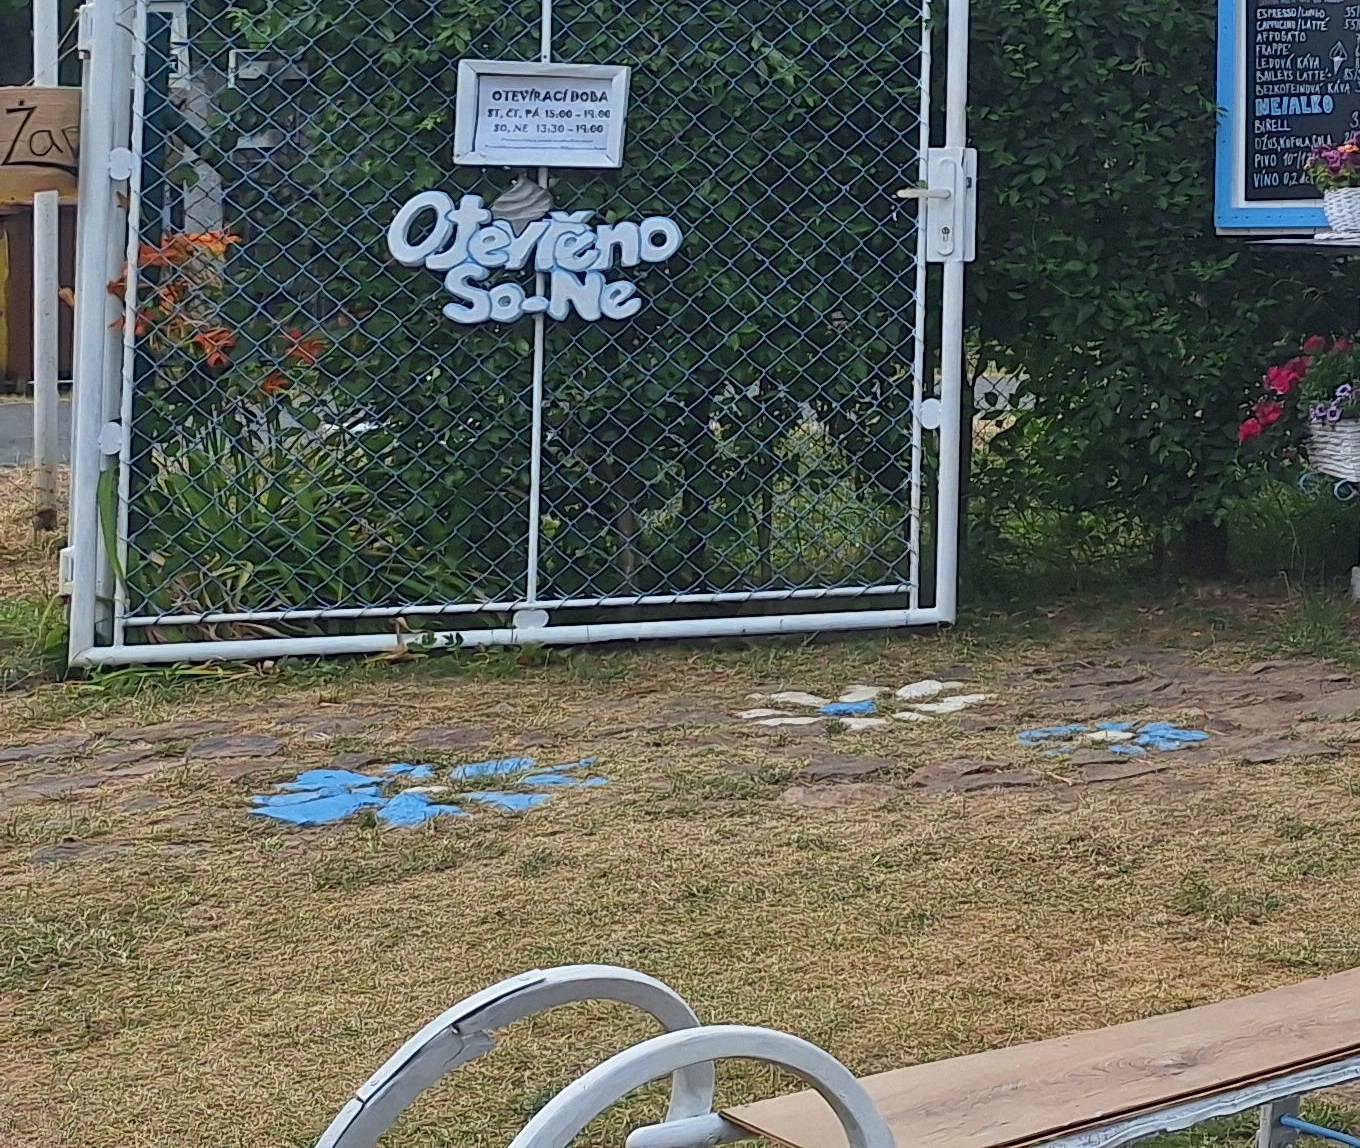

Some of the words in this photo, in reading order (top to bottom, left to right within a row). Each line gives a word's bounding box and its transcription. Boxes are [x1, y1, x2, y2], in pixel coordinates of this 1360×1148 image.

[1297, 53, 1320, 69] KÁVA
[1256, 70, 1294, 82] BAILEYS
[492, 88, 569, 102] OTEVÍRACÍ
[570, 90, 608, 102] DOBA
[1254, 119, 1292, 133] BIRELL
[1254, 153, 1277, 169] PIVO
[1253, 169, 1279, 188] VÍNO
[387, 190, 683, 272] Otevřeno
[443, 262, 642, 324] So-Ne
